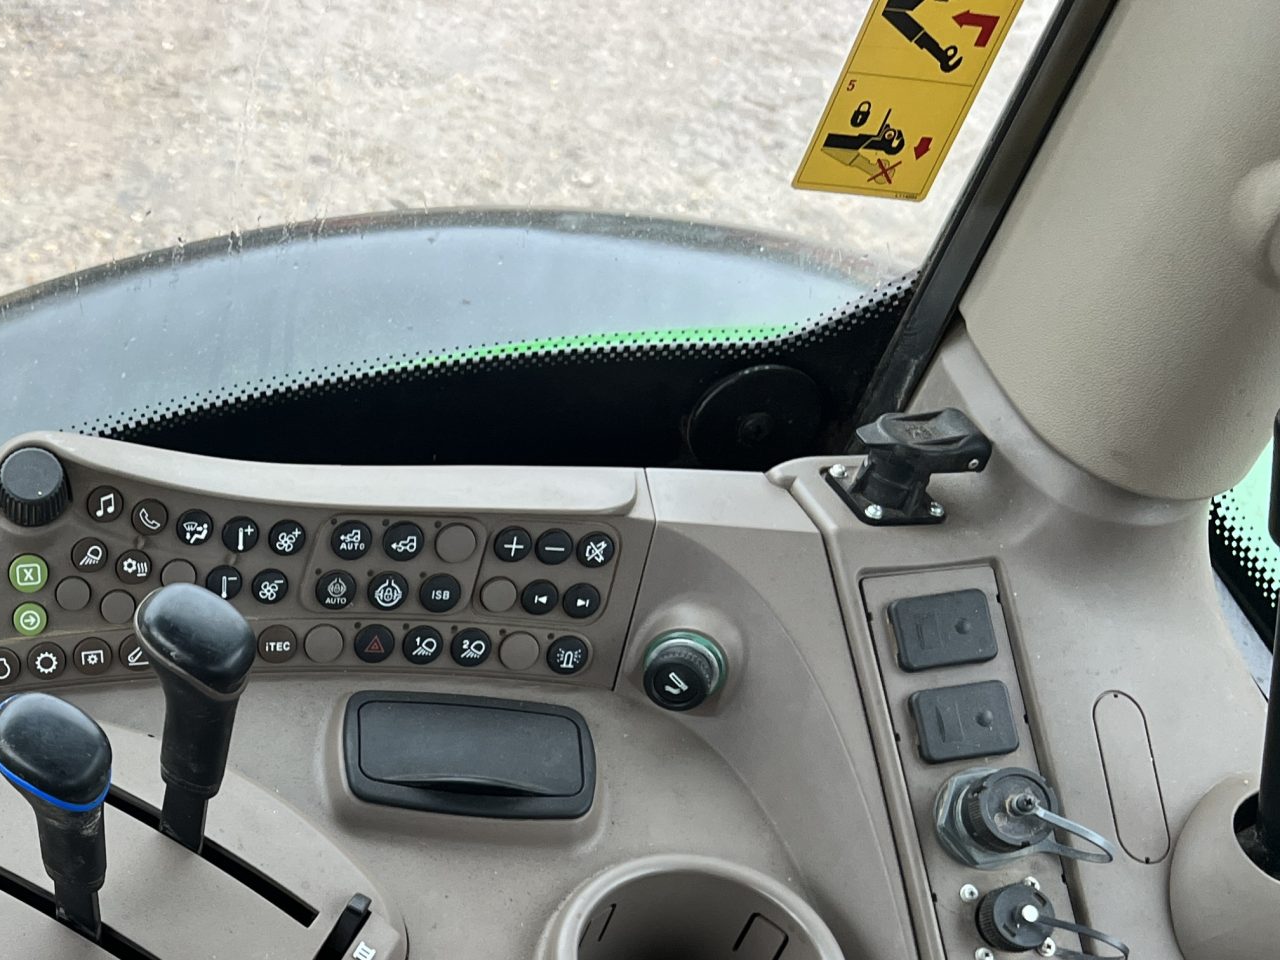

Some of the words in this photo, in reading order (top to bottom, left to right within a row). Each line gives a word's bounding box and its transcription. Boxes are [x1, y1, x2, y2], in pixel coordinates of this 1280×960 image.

[846, 79, 857, 92] 5
[339, 541, 365, 551] AUTO
[431, 590, 450, 600] ISB
[325, 597, 347, 605] AUTO
[265, 641, 291, 652] iTEC
[462, 640, 469, 649] 2
